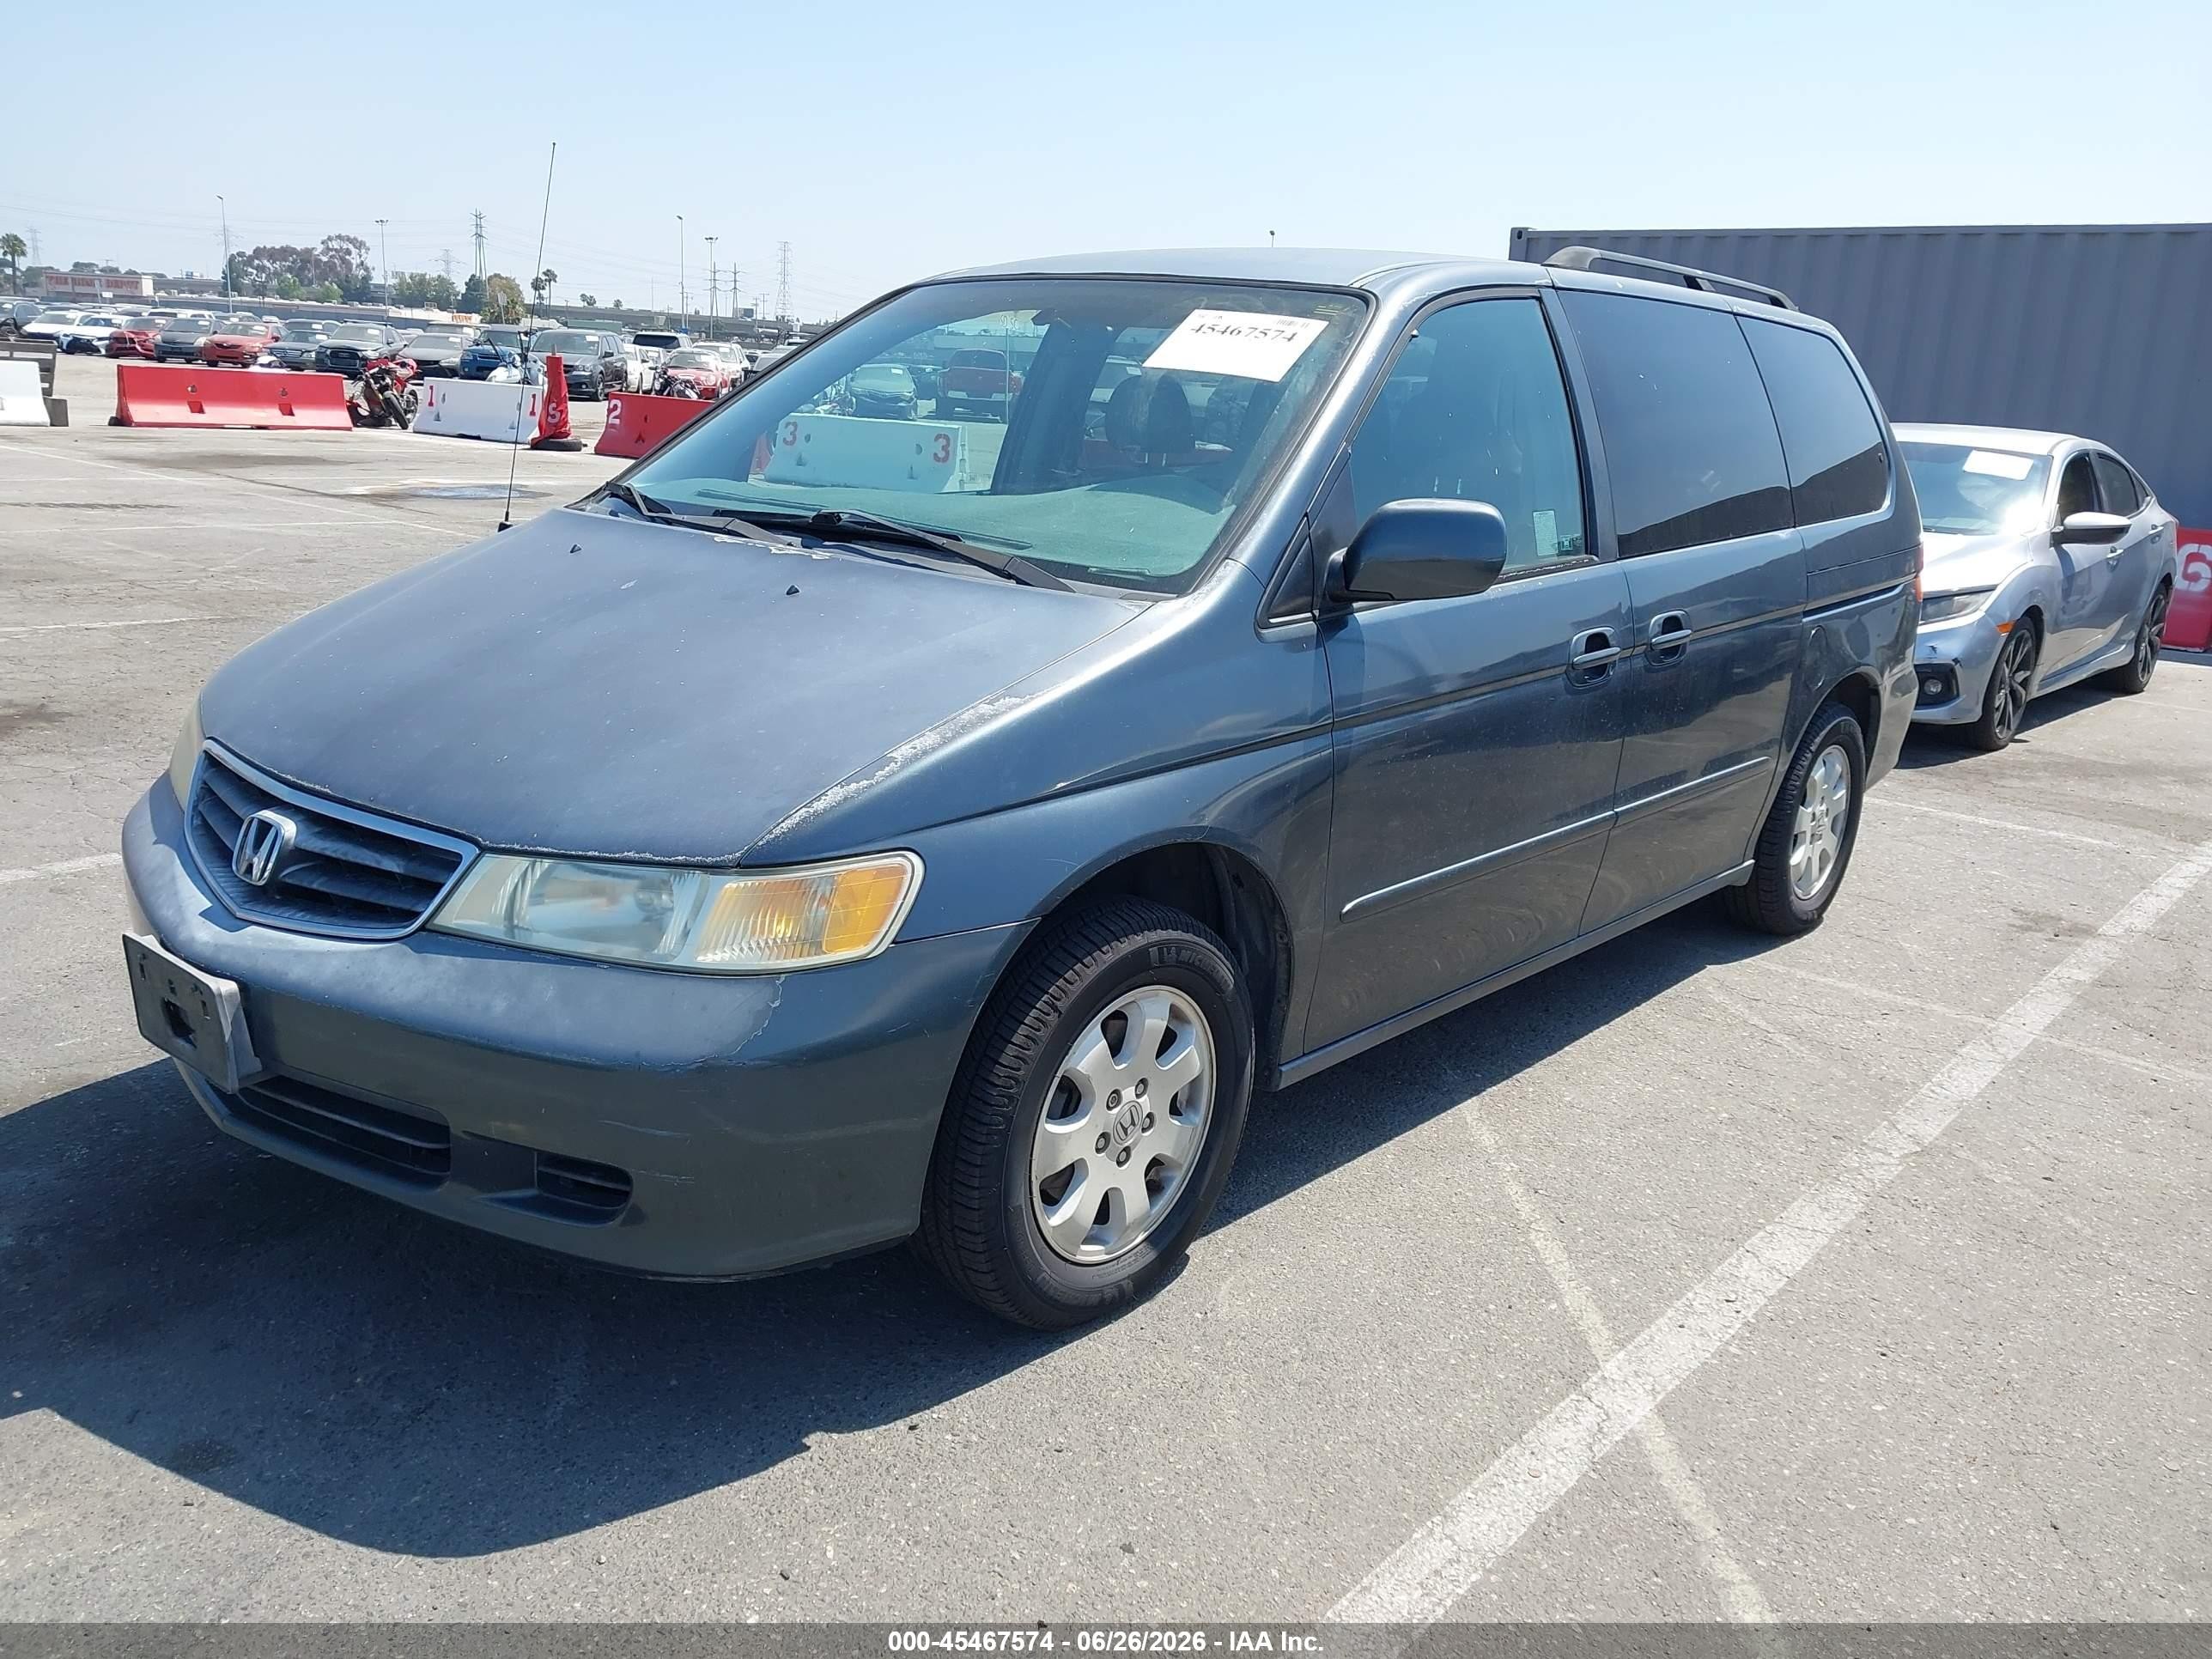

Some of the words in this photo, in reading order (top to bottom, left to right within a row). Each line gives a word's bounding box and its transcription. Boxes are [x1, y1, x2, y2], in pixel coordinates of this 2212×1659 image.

[1191, 323, 1297, 342] 45467574
[428, 386, 434, 406] 1
[530, 394, 536, 416] 1
[609, 399, 622, 424] 2
[782, 422, 798, 446] 3
[933, 433, 951, 463] 3
